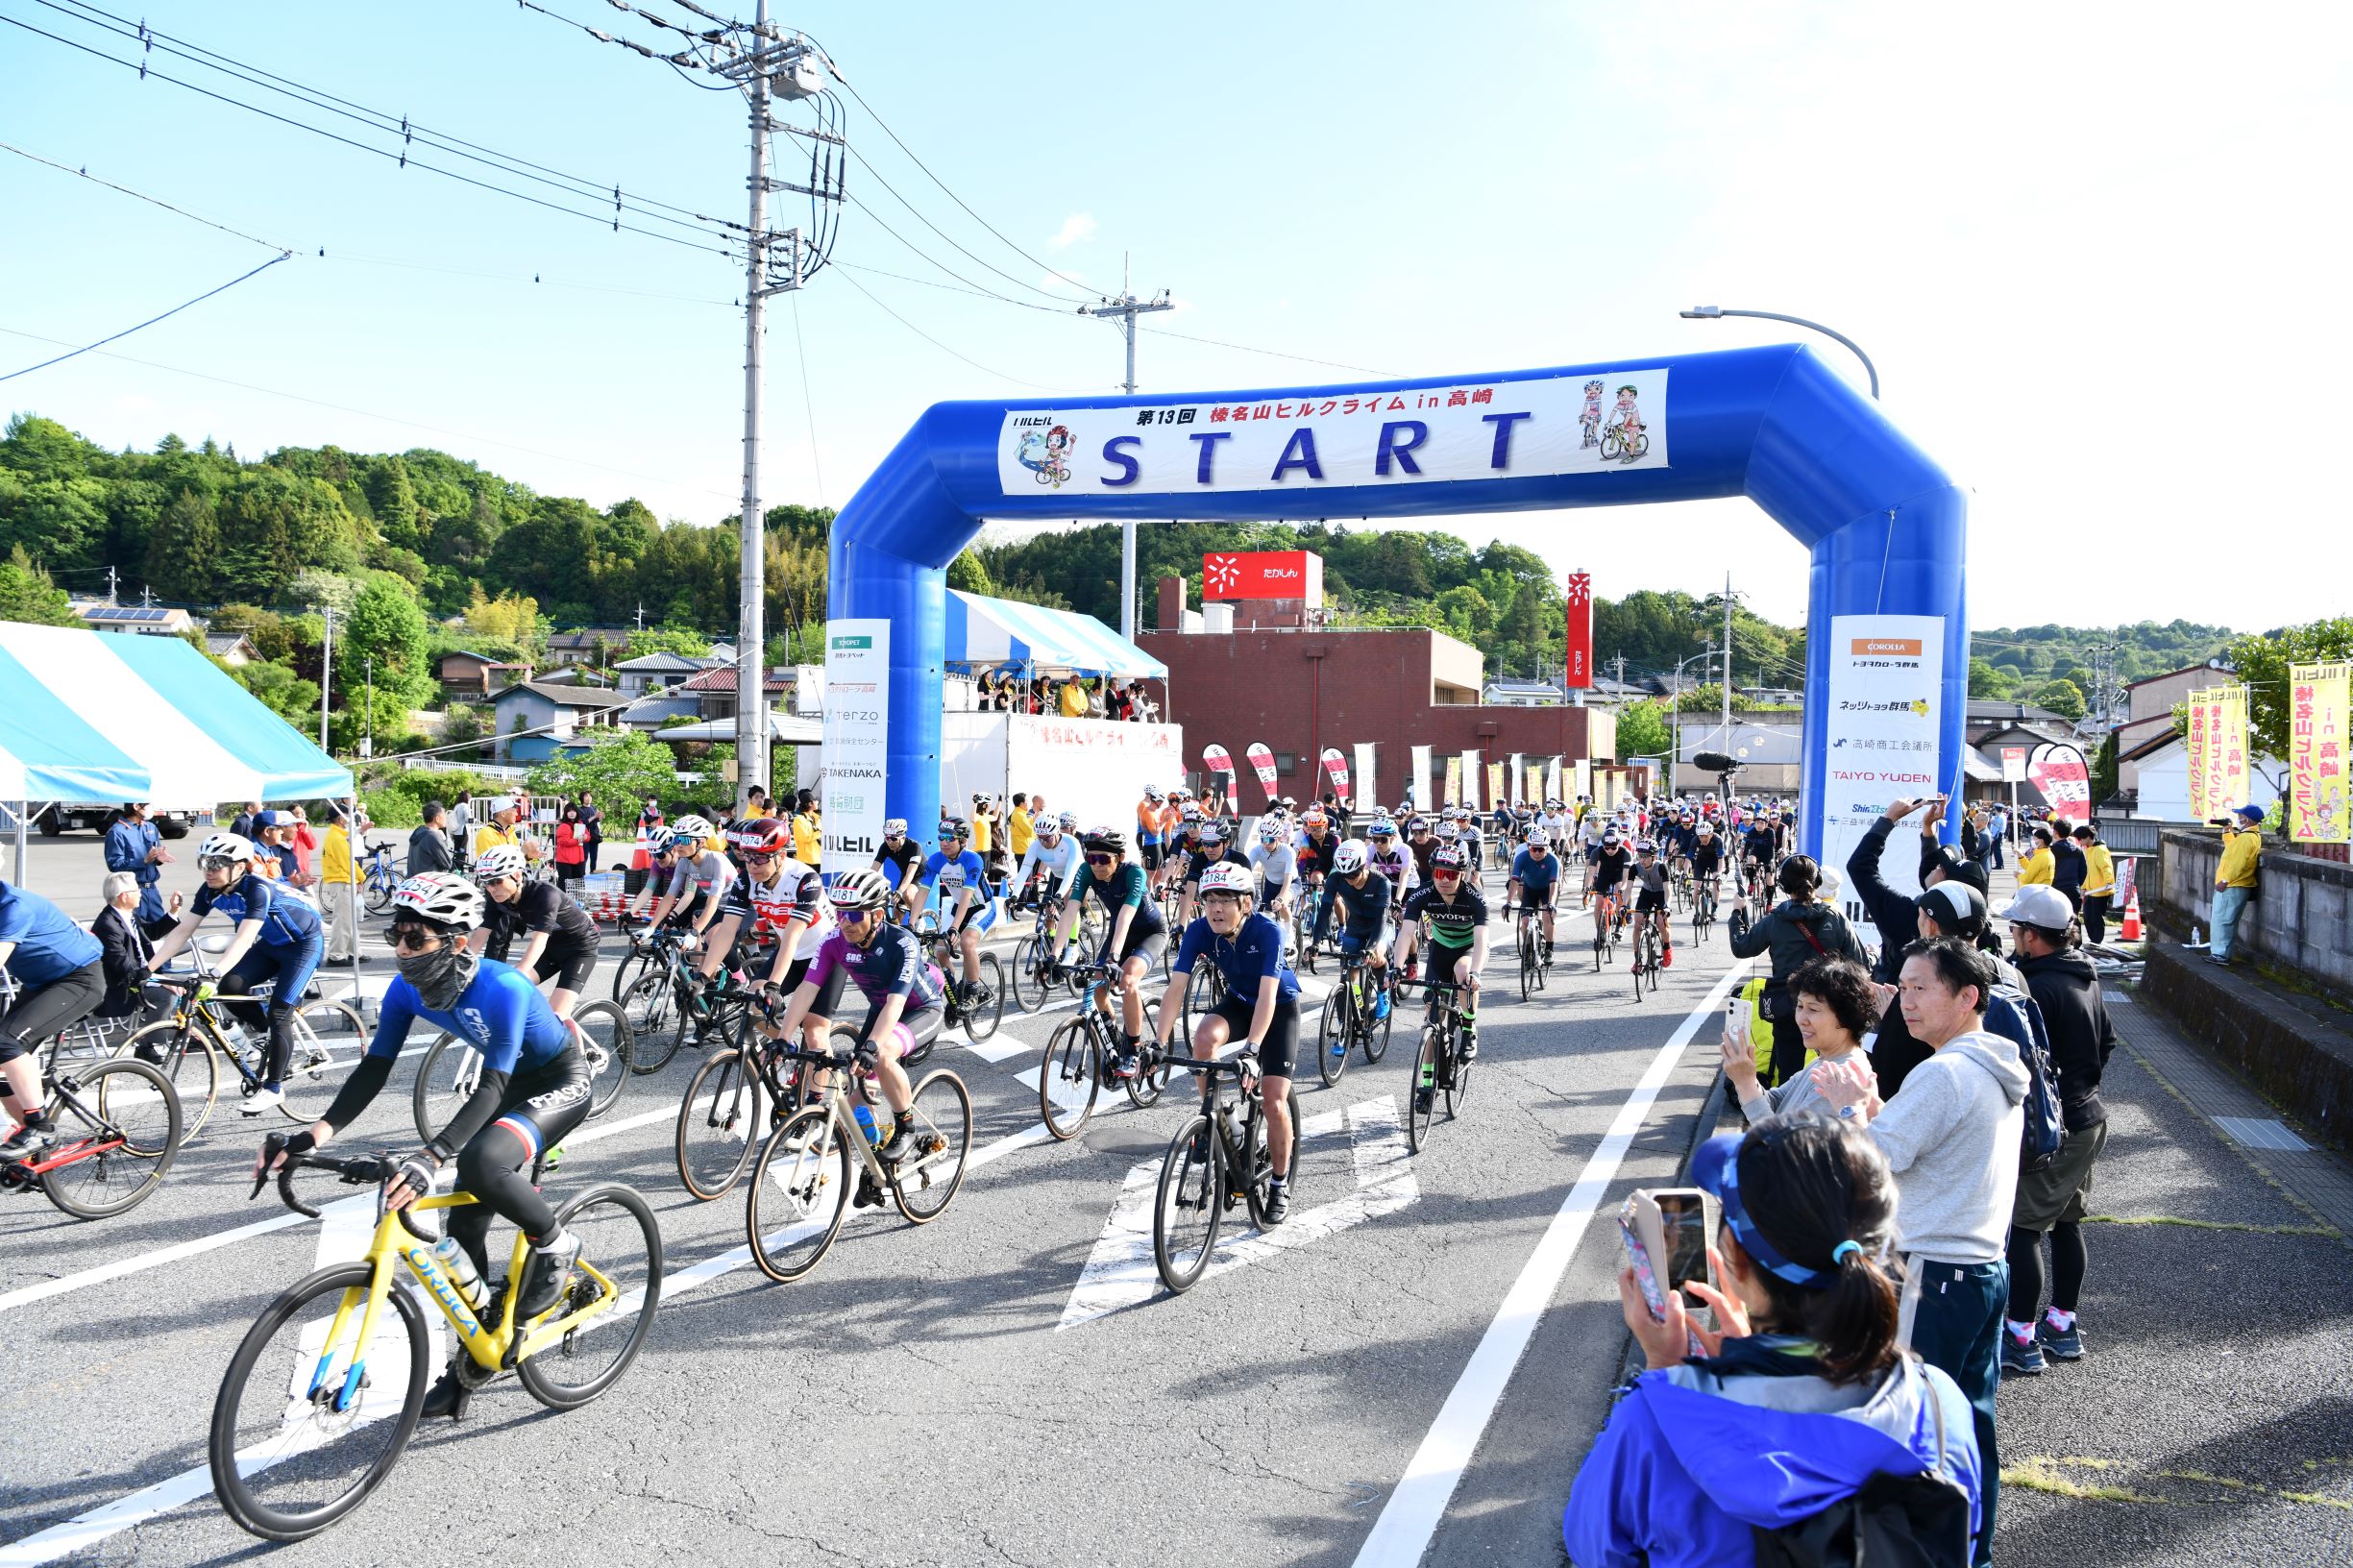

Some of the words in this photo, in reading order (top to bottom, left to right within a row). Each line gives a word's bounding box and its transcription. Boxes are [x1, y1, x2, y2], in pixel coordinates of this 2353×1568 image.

[1137, 408, 1197, 426] 第13回
[1210, 395, 1406, 423] 榛名山ヒルクライム
[1417, 394, 1439, 408] in
[1447, 387, 1494, 407] 高崎
[1099, 410, 1532, 486] START
[1263, 568, 1298, 578] たかしん
[1867, 643, 1906, 651] COROLLA
[1574, 649, 1582, 675] たかしん
[1852, 660, 1920, 669] トヨタカローラ群馬
[1839, 700, 1911, 712] ネッツトヨタ群馬
[1852, 738, 1933, 752] 高崎商工会議所
[829, 769, 882, 778] TAKENAKA
[1832, 771, 1875, 781] TAIYO
[1879, 772, 1931, 783] YUDEN
[1437, 851, 1457, 860] 4240
[846, 952, 862, 962] SBC
[408, 1248, 478, 1338] ORBEA
